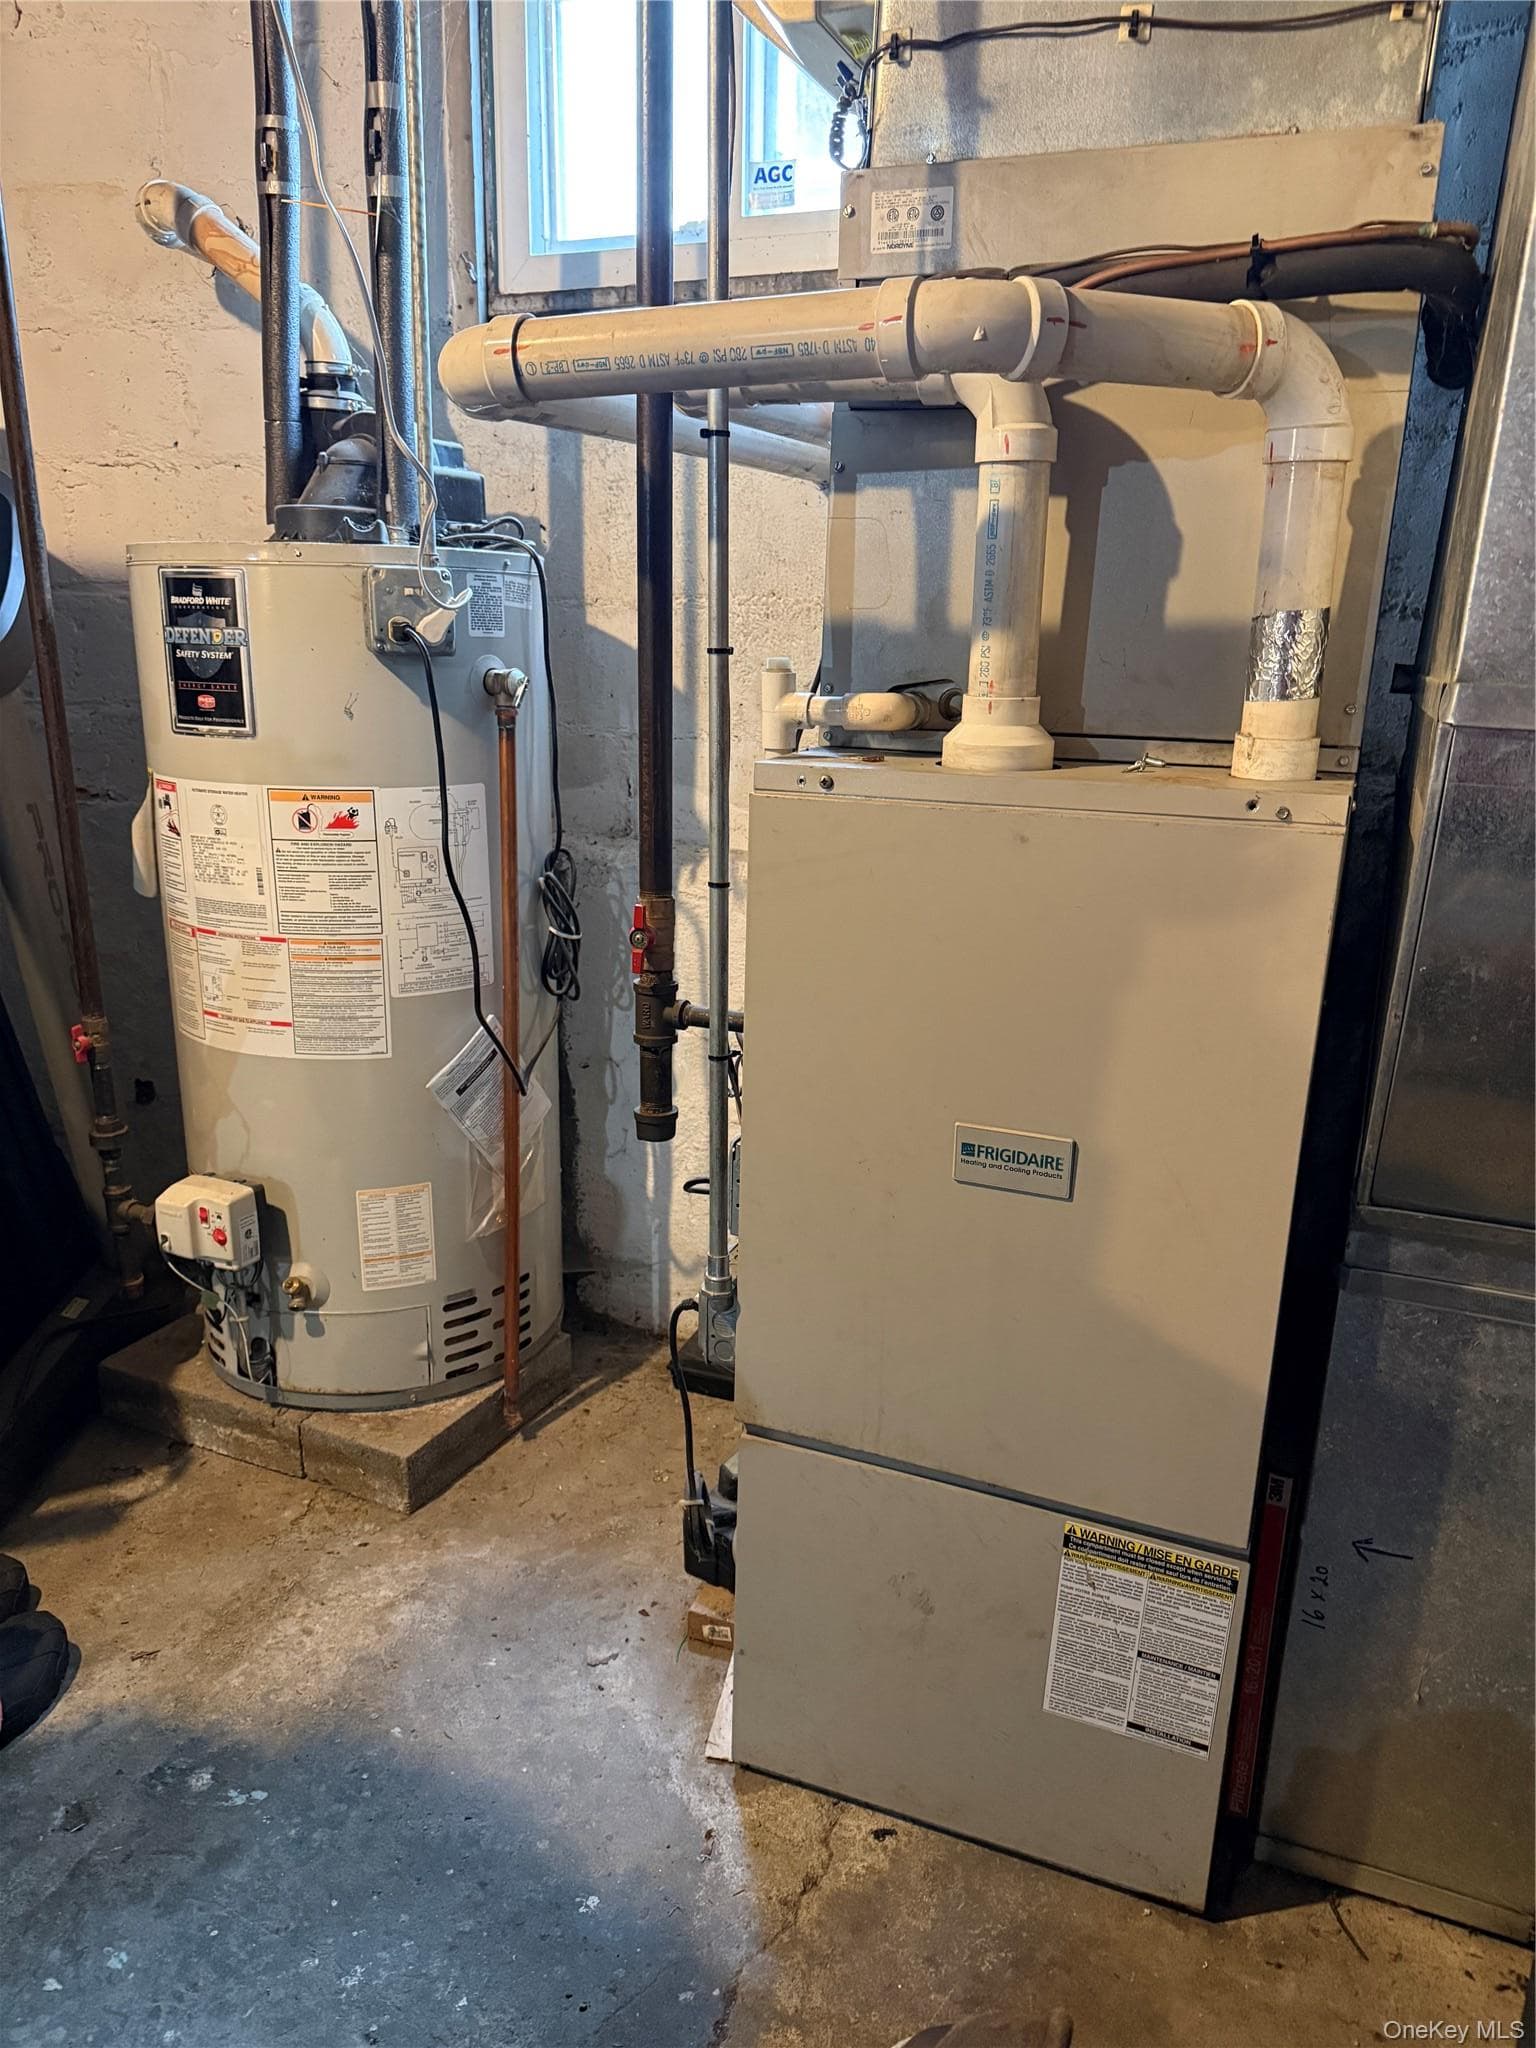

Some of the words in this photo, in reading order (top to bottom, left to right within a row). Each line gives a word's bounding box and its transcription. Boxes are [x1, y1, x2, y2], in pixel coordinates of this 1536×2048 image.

[753, 164, 794, 184] AGC
[712, 348, 726, 363] PSI
[832, 337, 858, 354] ASTM
[613, 354, 635, 370] 2665
[646, 351, 670, 368] ASTM
[985, 544, 996, 565] 2665
[983, 579, 994, 602] ASTM
[170, 596, 204, 605] BRADFORD
[205, 596, 231, 606] WHITE
[165, 626, 248, 646] DEFENDER
[176, 649, 200, 659] SAFETY
[201, 650, 233, 660] SYSTEM
[976, 1144, 1065, 1171] FRIGIDAIRE
[960, 1157, 987, 1169] Heating
[1003, 1164, 1031, 1176] Cooling
[1032, 1169, 1063, 1180] Products
[1267, 1477, 1284, 1501] 3M
[1079, 1528, 1136, 1551] WARNING
[1143, 1545, 1172, 1561] MISE
[1175, 1553, 1192, 1566] EN
[1194, 1558, 1238, 1579] GARDE
[1309, 1566, 1329, 1587] 20
[1301, 1609, 1325, 1629] 16
[1141, 1652, 1183, 1669] MAINTENANCE
